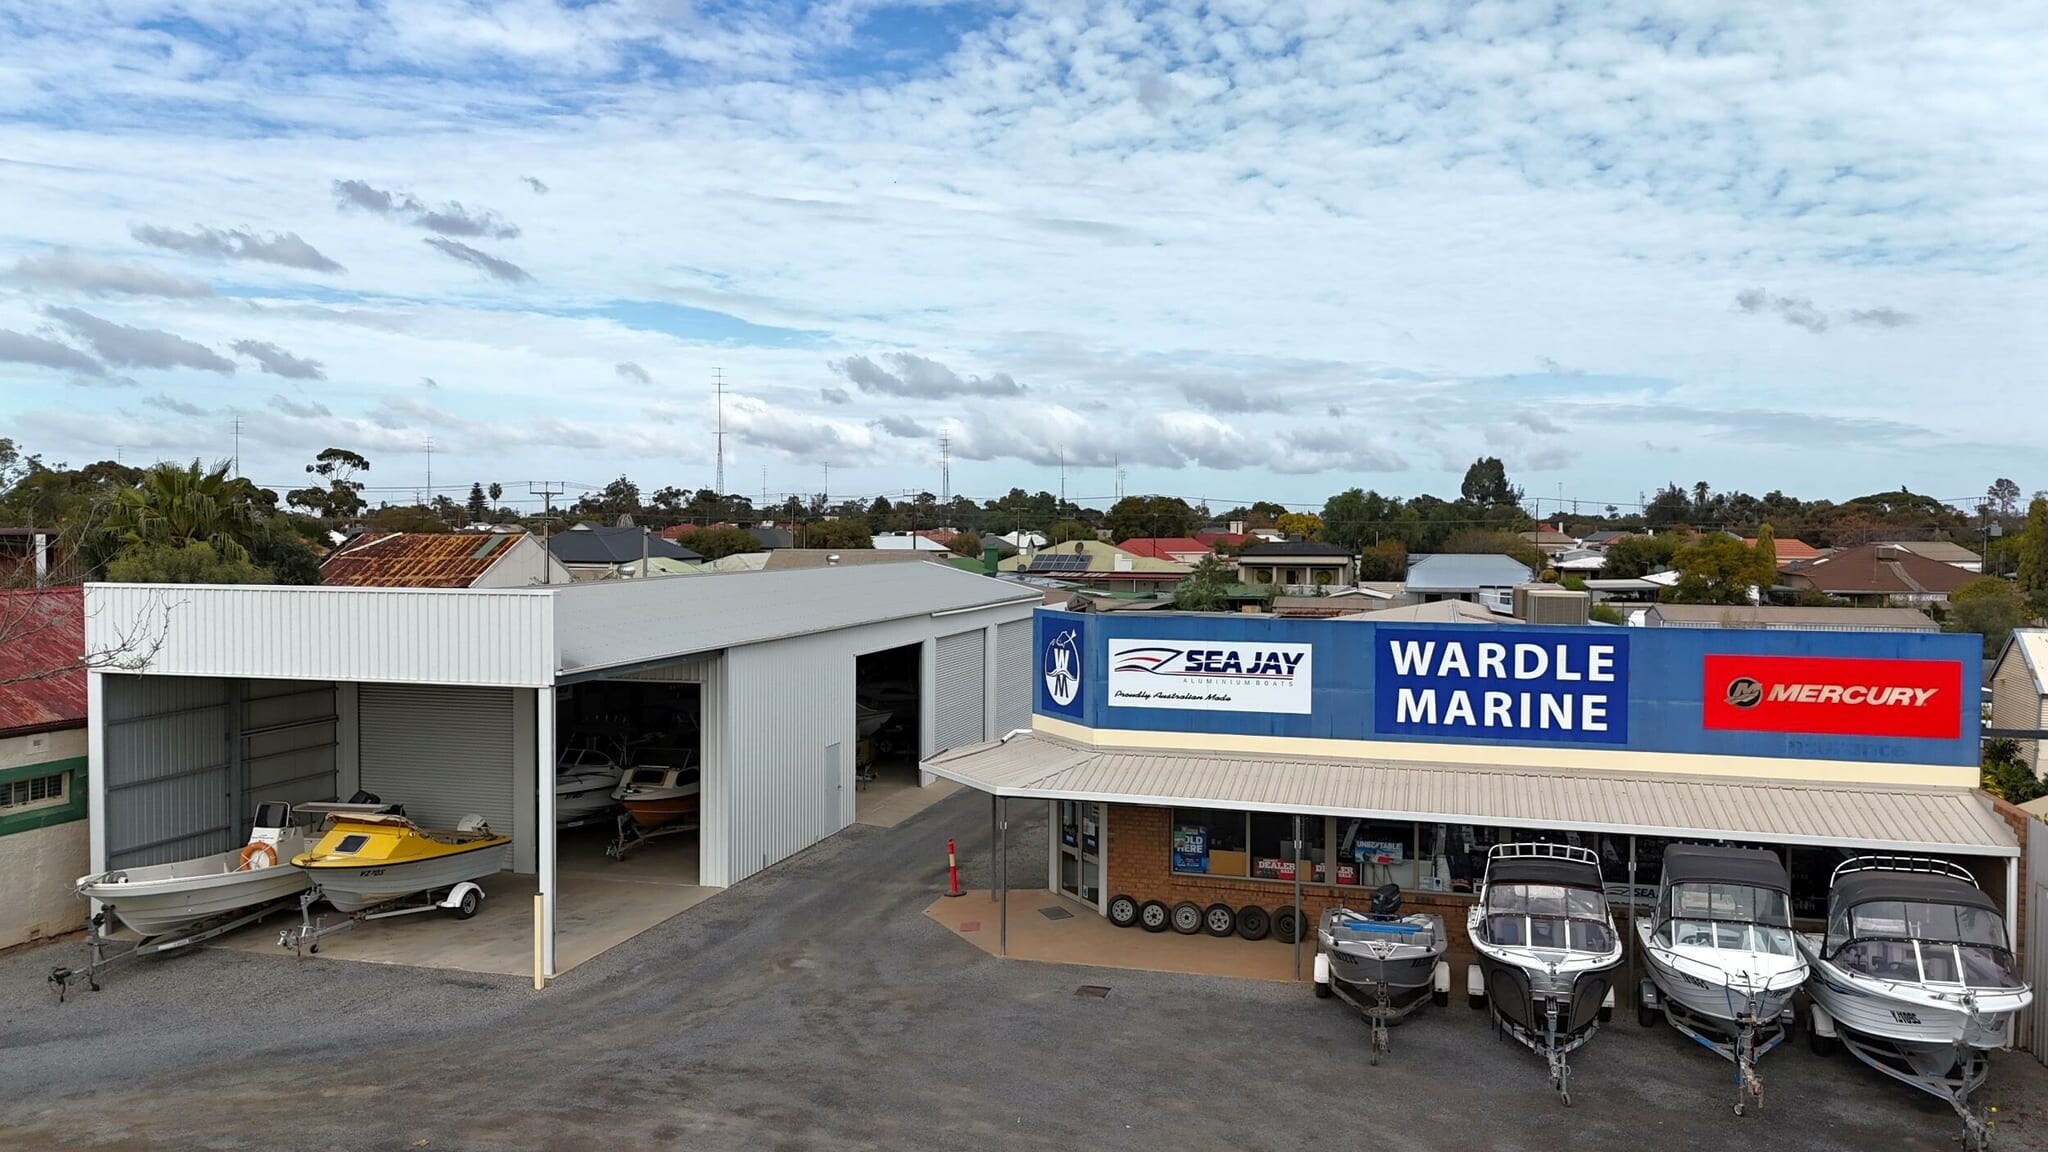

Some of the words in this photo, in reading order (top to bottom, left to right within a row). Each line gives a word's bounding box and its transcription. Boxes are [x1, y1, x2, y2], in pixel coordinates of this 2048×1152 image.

[1184, 650, 1243, 673] SEA
[1246, 652, 1305, 675] JAY
[1389, 640, 1615, 682] WARDLE
[1183, 678, 1250, 686] ALUMINIUM
[1255, 679, 1294, 687] BOATS
[1114, 689, 1151, 701] Proudly
[1152, 691, 1204, 700] Australian
[1205, 693, 1232, 701] Made
[1766, 684, 1939, 707] MERCURY
[1396, 688, 1608, 731] MARINE
[1258, 860, 1296, 870] DEALER
[1634, 887, 1656, 898] SEA
